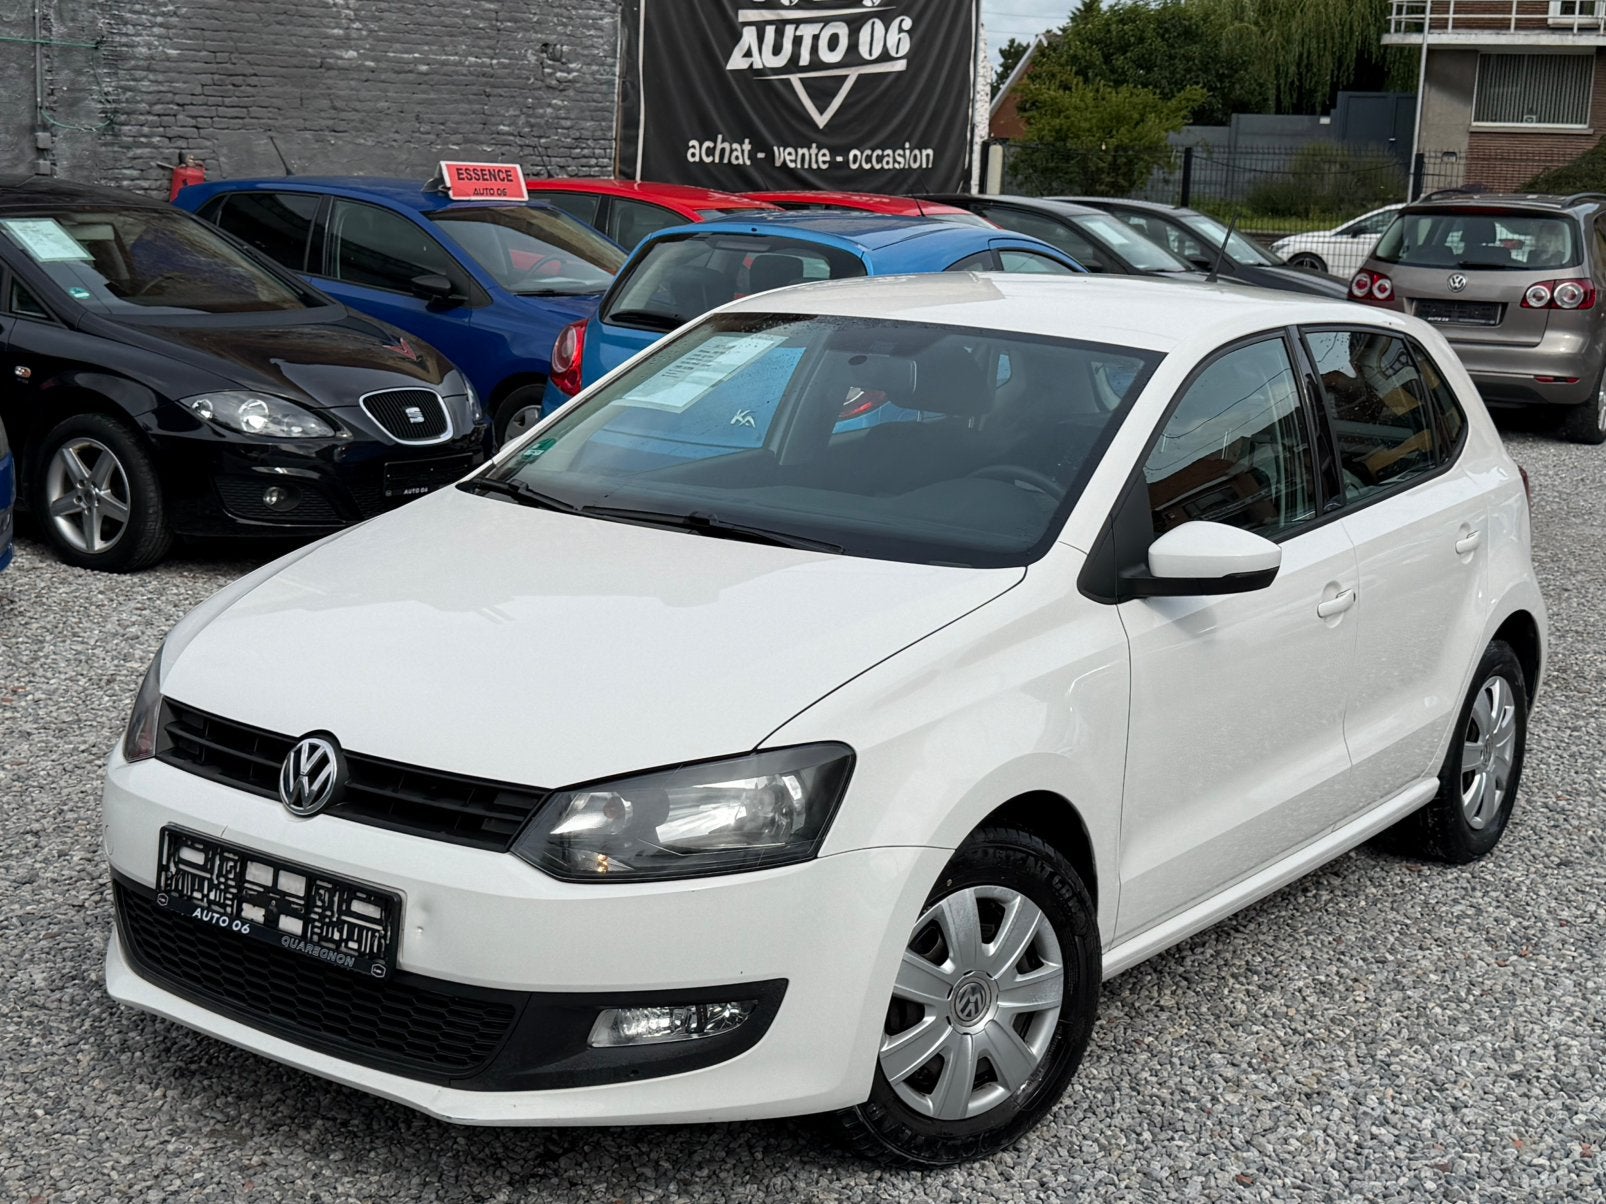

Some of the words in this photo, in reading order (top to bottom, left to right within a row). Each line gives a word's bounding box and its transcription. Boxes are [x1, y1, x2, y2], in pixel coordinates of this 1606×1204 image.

[726, 21, 849, 70] AUTO
[858, 15, 912, 61] 06
[686, 134, 751, 166] achat
[773, 143, 830, 169] vente
[849, 142, 934, 170] occasion
[456, 168, 513, 182] ESSENCE
[473, 188, 495, 196] AUTO
[192, 907, 229, 927] AUTO
[231, 919, 251, 935] 06
[281, 935, 355, 968] QUAREGNON
